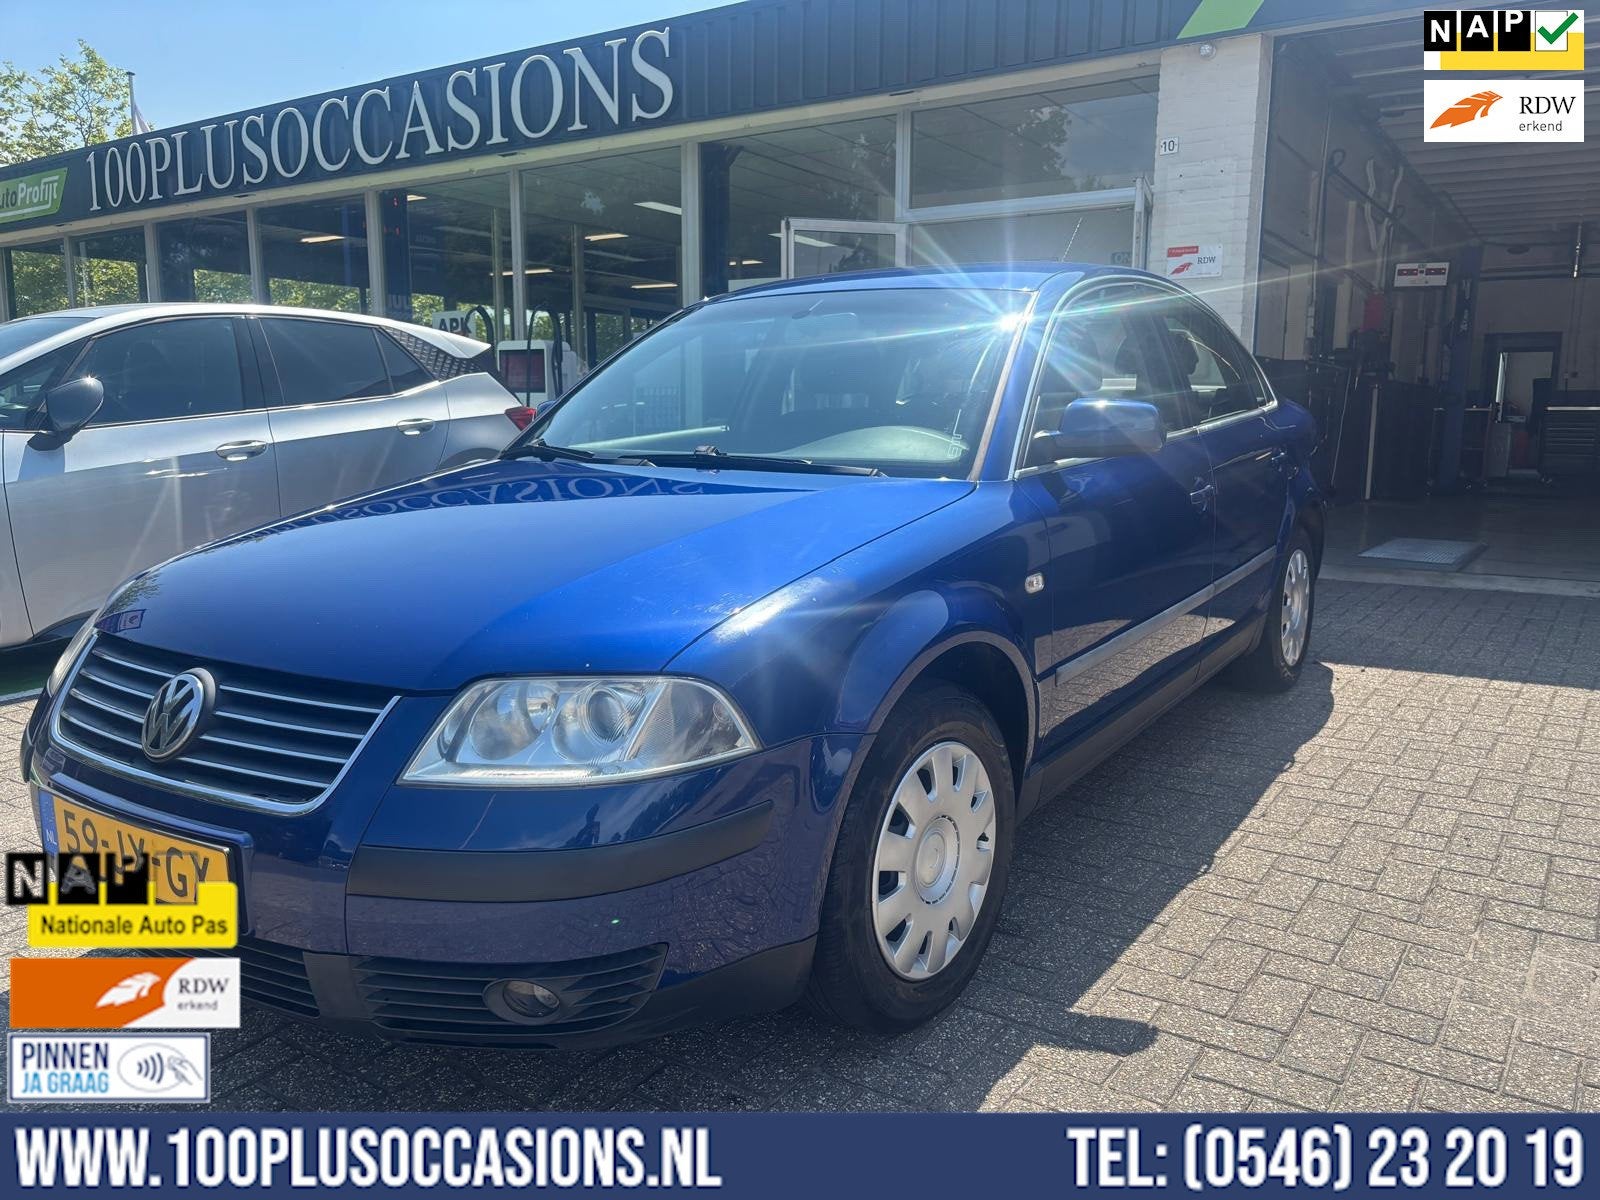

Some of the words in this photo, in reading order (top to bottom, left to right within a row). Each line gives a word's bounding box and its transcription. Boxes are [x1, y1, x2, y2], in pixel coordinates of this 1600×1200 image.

[86, 26, 674, 211] 100PLUSOCCASIONS
[1162, 140, 1175, 152] 10
[1197, 256, 1216, 264] RDW
[438, 317, 472, 335] APK
